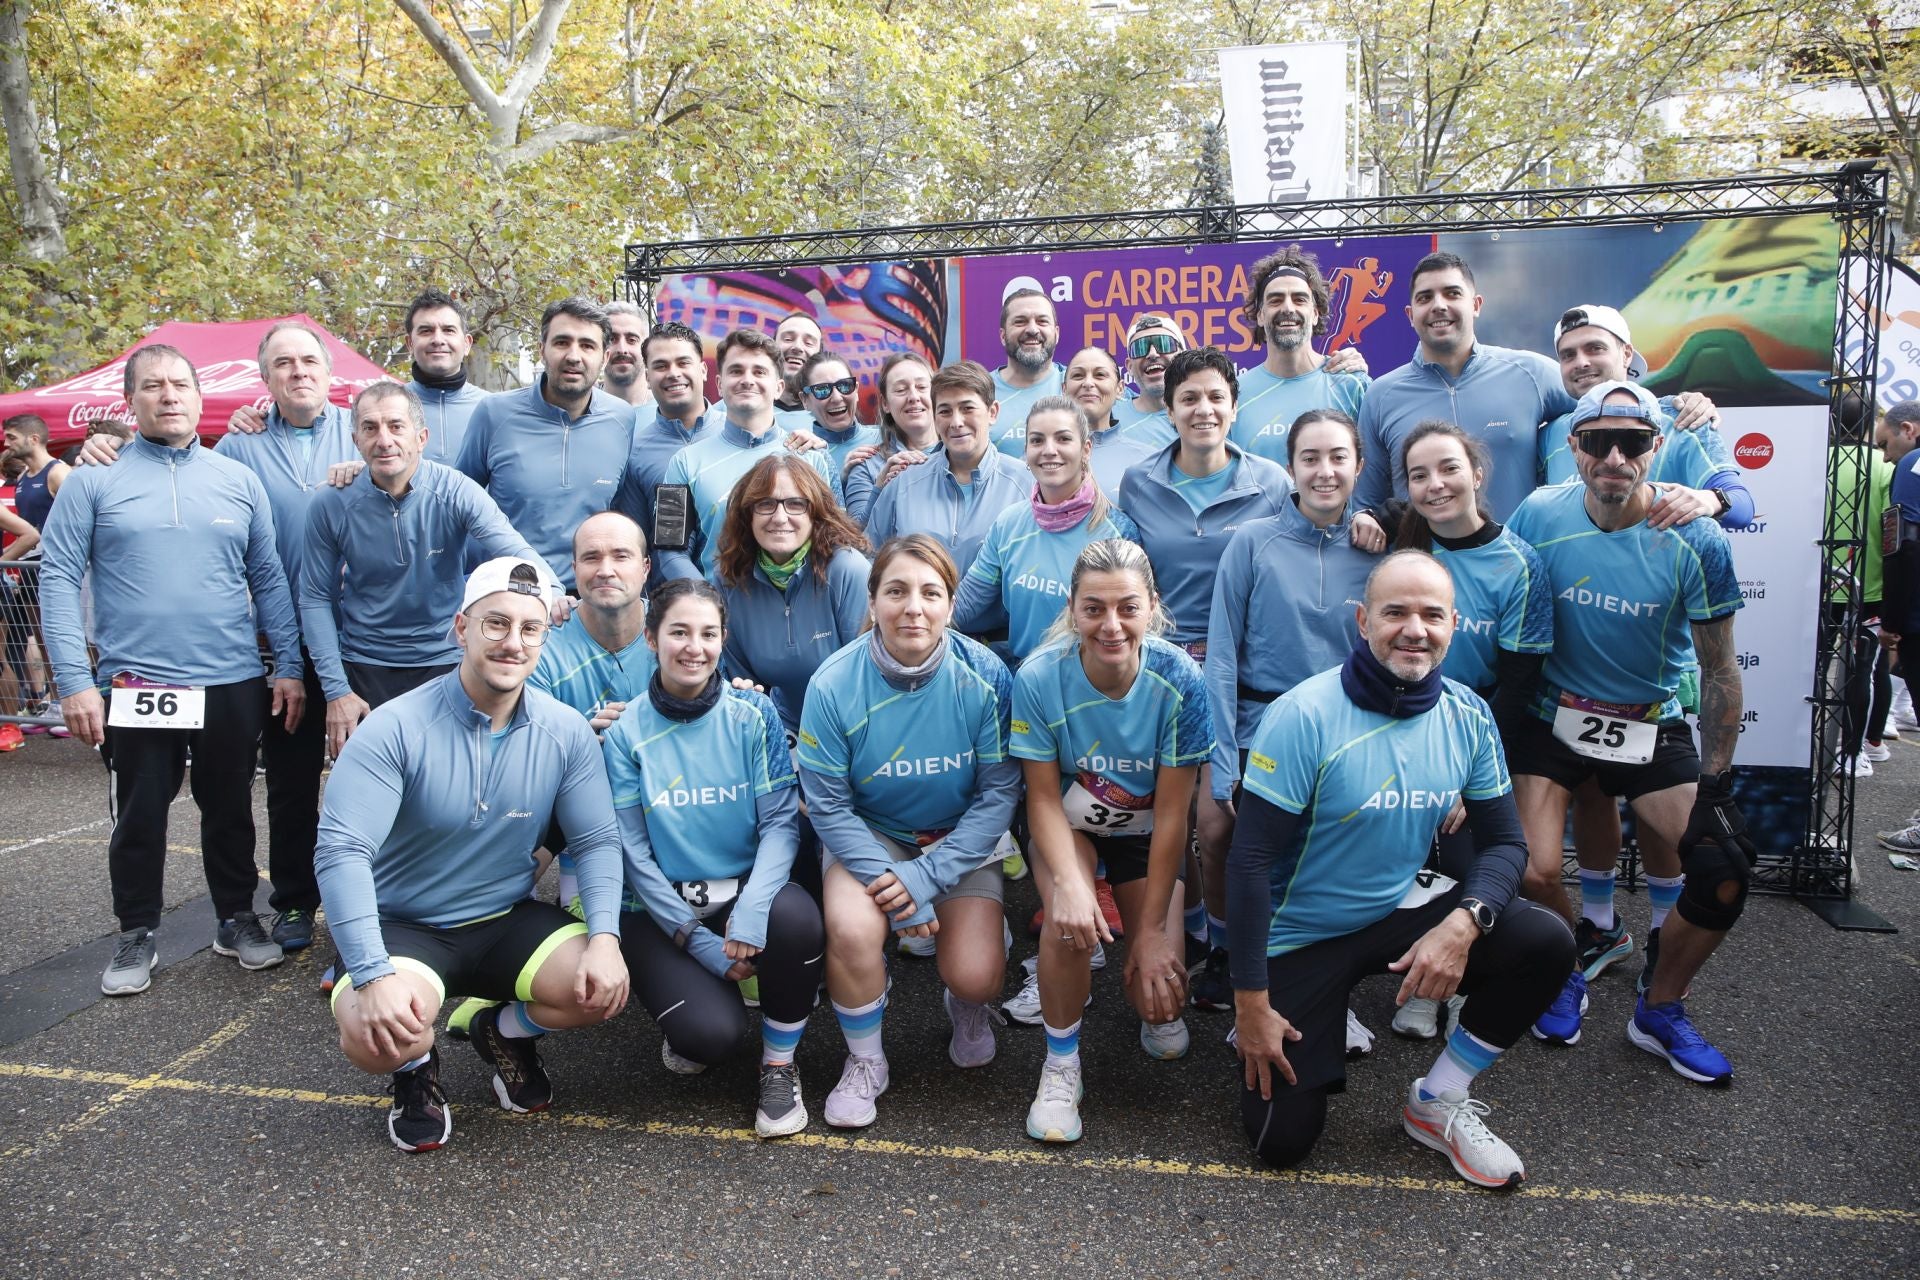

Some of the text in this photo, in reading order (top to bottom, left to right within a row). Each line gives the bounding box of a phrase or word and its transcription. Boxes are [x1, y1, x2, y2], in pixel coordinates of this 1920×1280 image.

[1082, 264, 1250, 308] CARRERA
[1736, 445, 1772, 456] Coca-Cola
[1013, 573, 1071, 598] ADIEN
[1558, 586, 1661, 617] ADIENT
[134, 691, 178, 716] 56
[1577, 716, 1628, 748] 25
[872, 749, 974, 778] ADIENT
[1075, 755, 1154, 773] ADIEN
[650, 781, 750, 807] ADIENT
[1360, 789, 1460, 810] ADIENT
[1084, 803, 1135, 828] 32
[686, 880, 710, 908] 3
